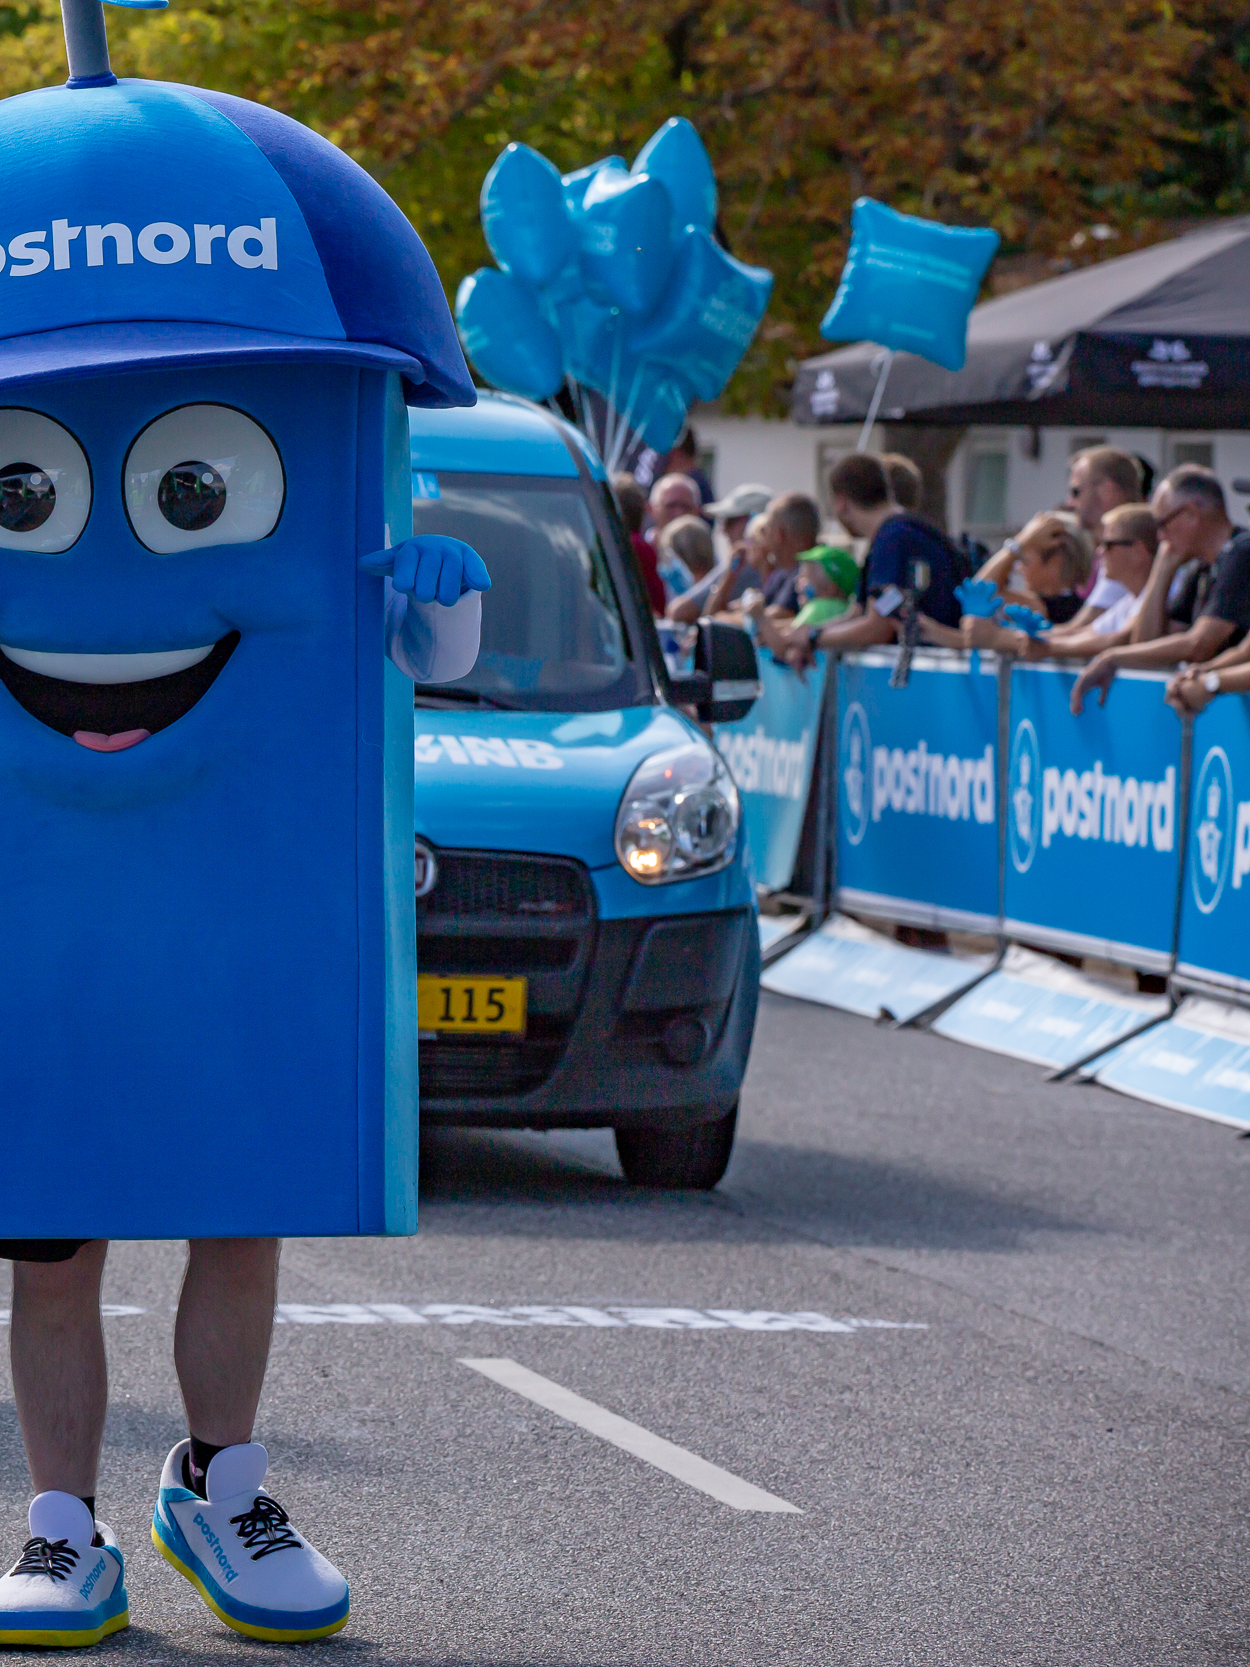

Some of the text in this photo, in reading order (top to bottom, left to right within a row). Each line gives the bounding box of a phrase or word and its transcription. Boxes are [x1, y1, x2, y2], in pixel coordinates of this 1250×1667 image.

[872, 740, 996, 824] postnord
[1042, 760, 1176, 852] postnord
[439, 987, 506, 1023] 115
[79, 1556, 107, 1602] postnord
[193, 1513, 239, 1583] postnord
